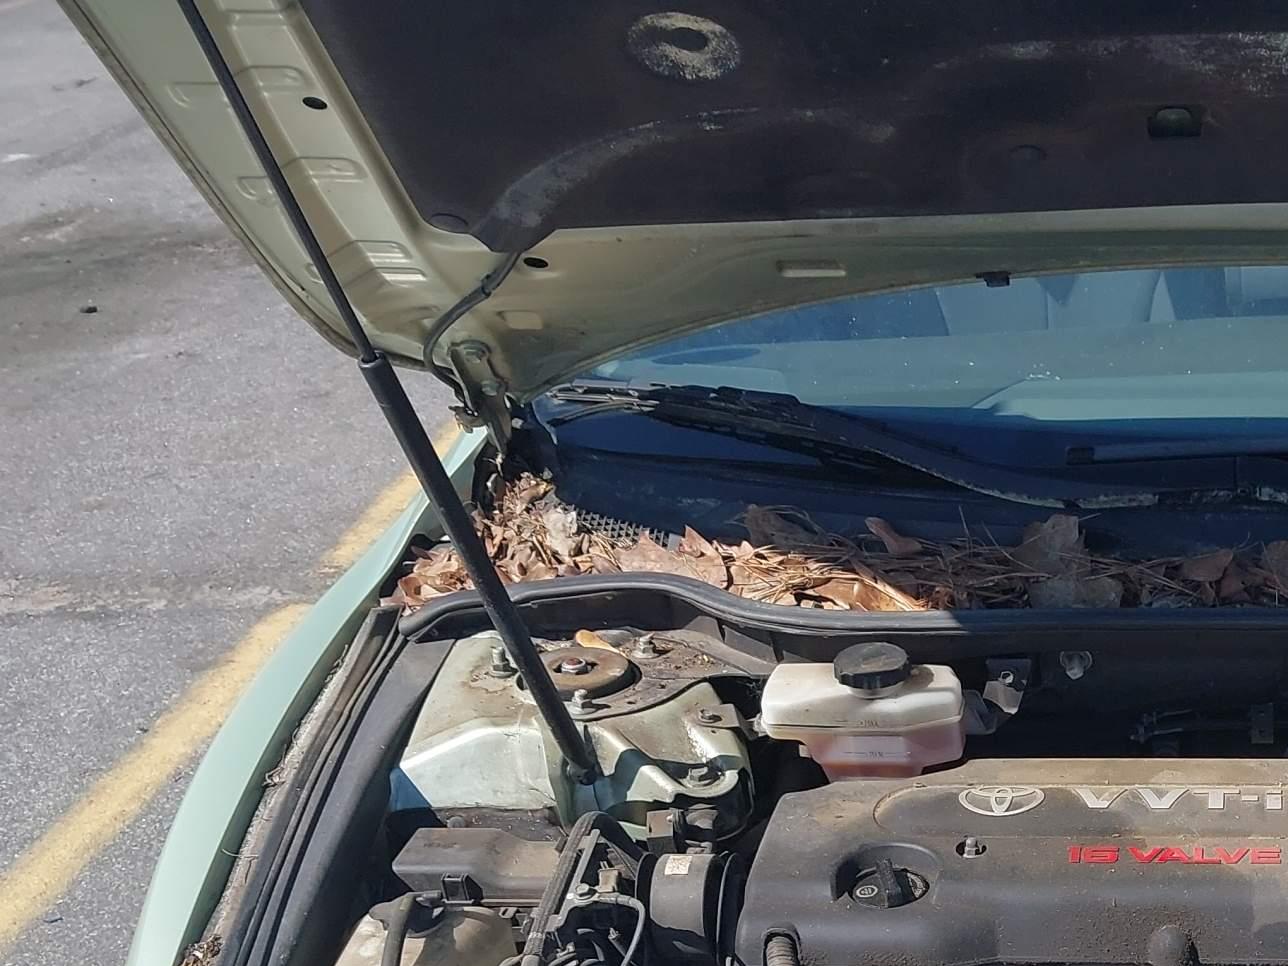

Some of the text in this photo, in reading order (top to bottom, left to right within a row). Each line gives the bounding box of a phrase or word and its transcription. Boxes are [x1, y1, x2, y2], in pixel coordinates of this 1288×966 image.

[1072, 788, 1284, 810] VVT-i
[1068, 847, 1283, 865] 16 VALVE
